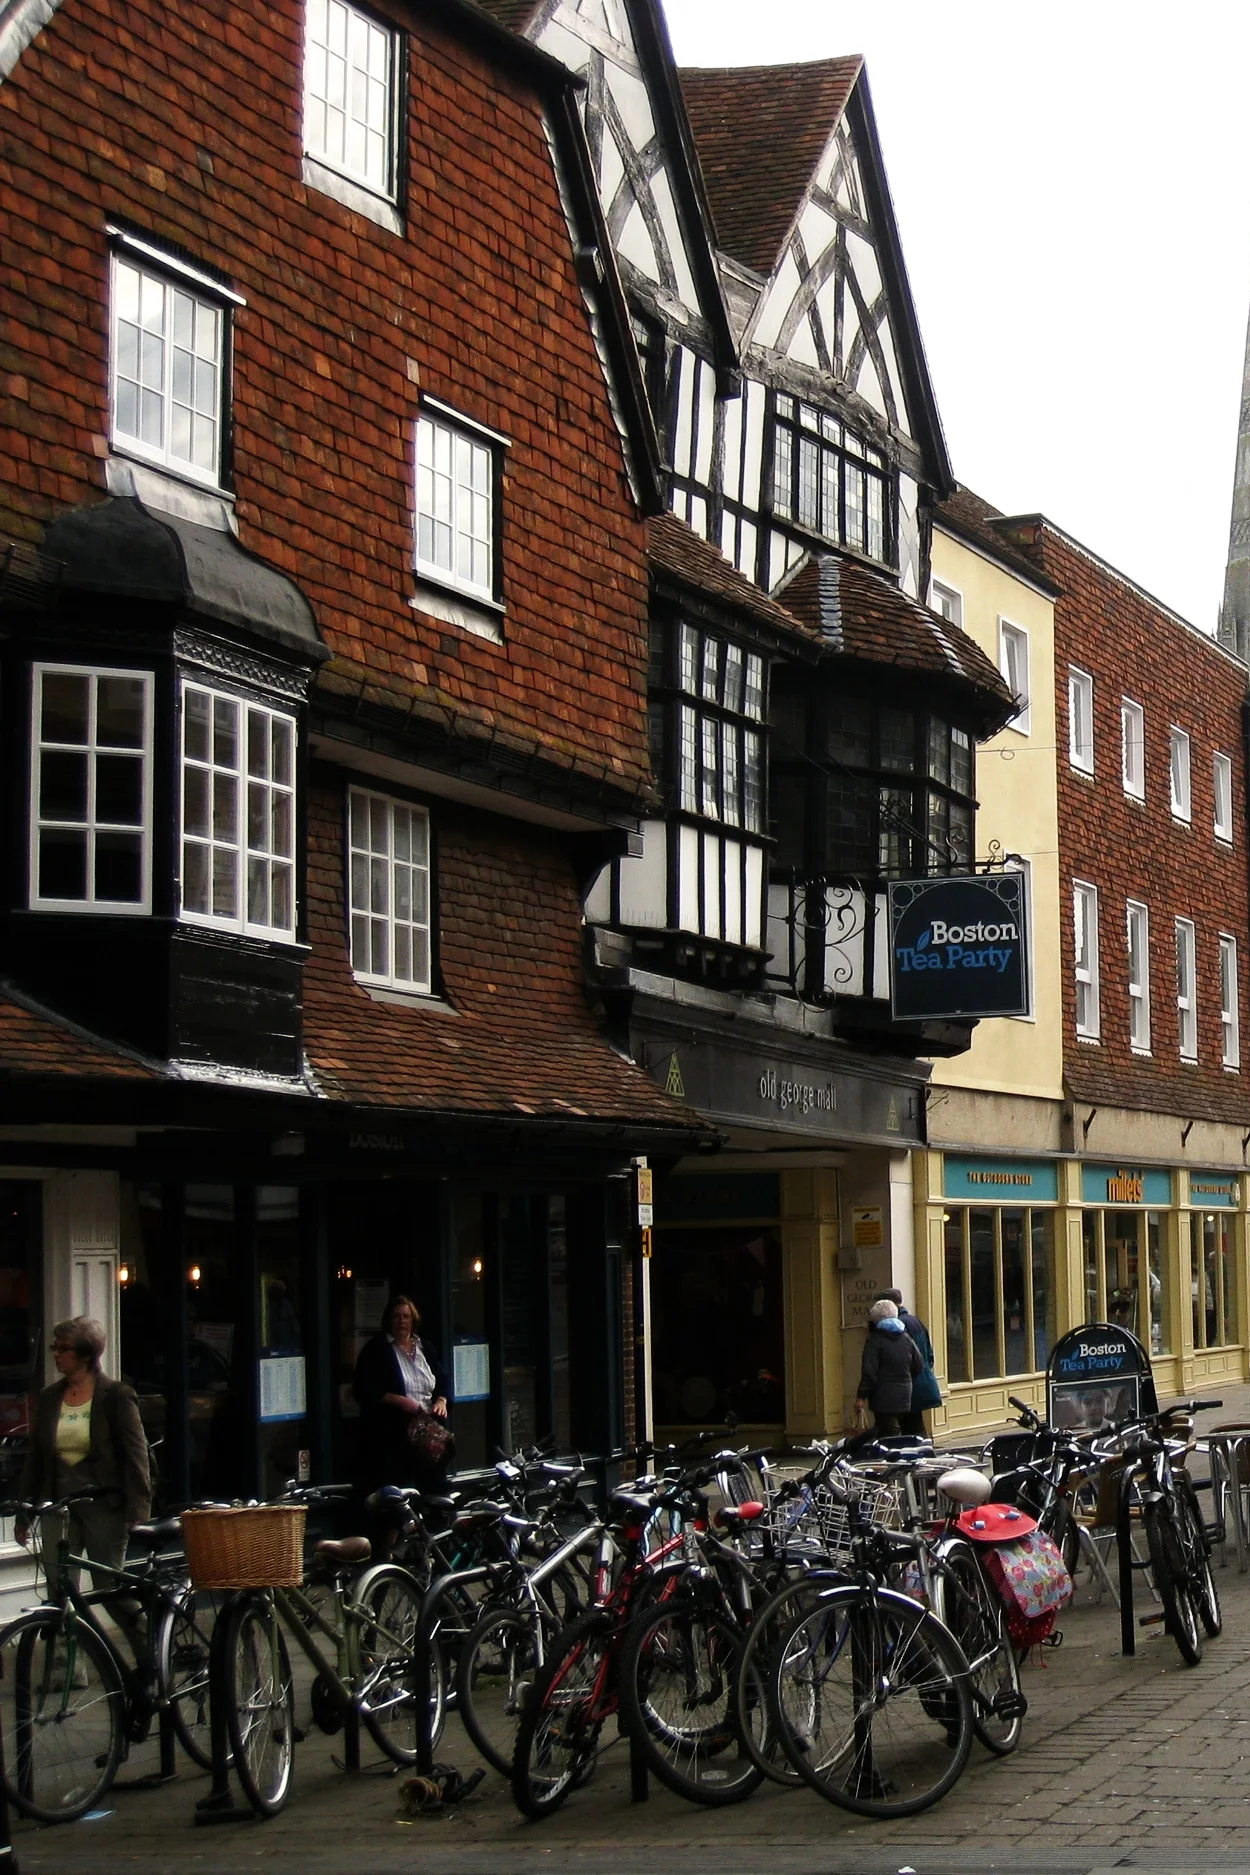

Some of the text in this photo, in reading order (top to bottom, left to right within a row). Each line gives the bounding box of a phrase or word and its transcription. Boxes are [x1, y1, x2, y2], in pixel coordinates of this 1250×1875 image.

[931, 920, 1018, 944] Boston
[896, 945, 1012, 972] Tea Party
[760, 1069, 837, 1114] old george mall
[1107, 1170, 1142, 1202] millets
[1079, 1343, 1127, 1357] Boston
[1060, 1356, 1124, 1372] Tea Party
